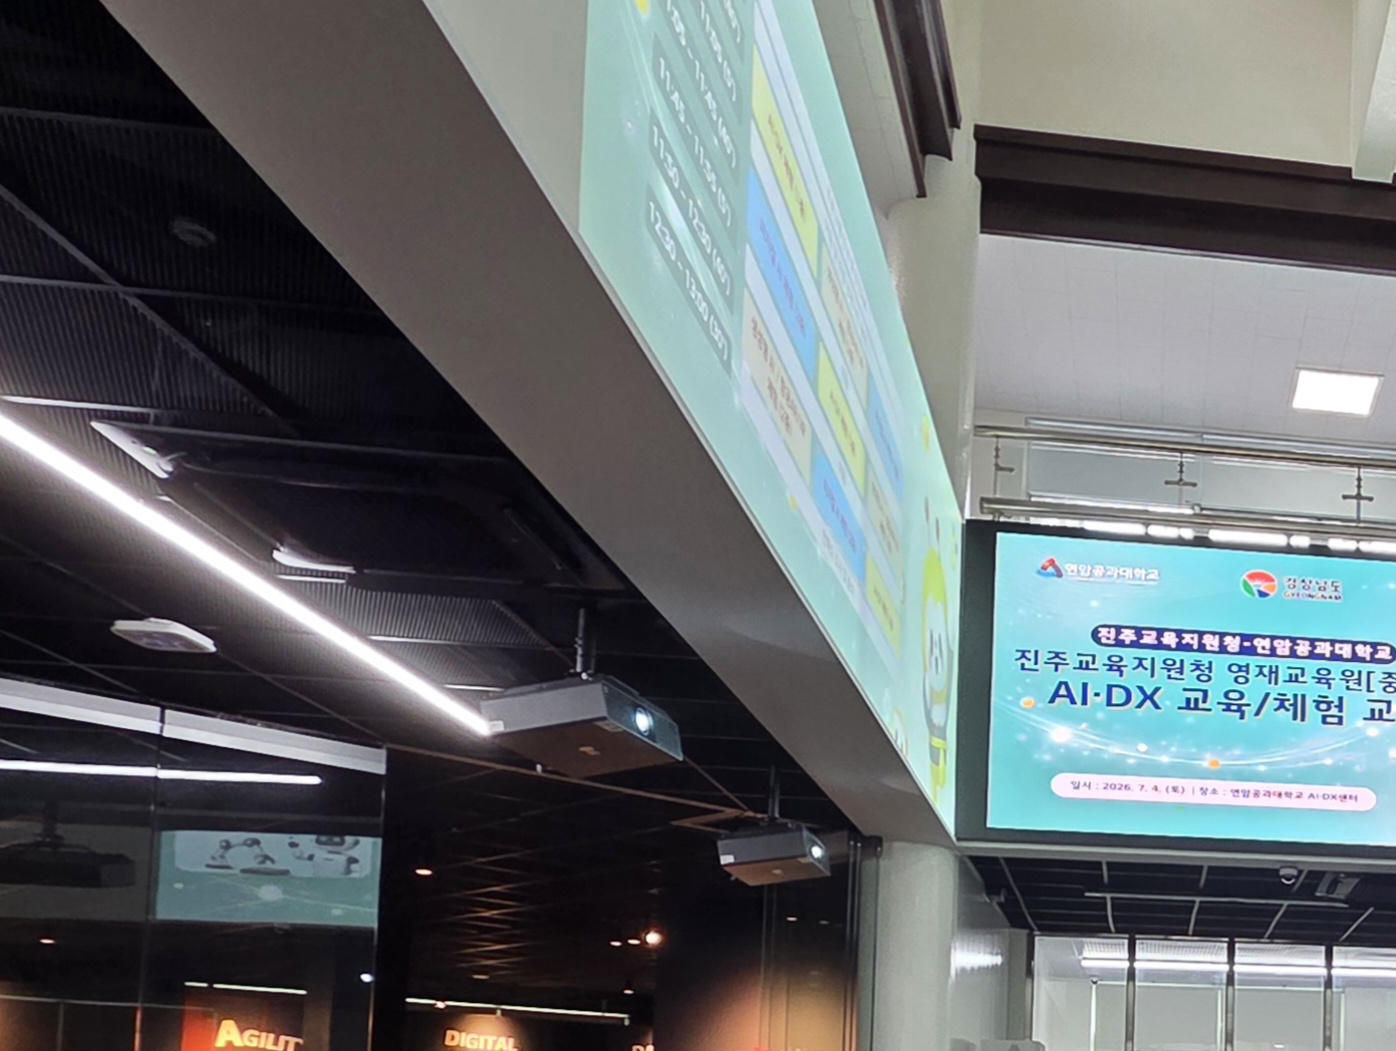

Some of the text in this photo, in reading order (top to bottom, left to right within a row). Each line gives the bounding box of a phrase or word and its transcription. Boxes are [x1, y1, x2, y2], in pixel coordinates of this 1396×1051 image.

[1065, 562, 1160, 581] 연암공과대학교
[1284, 577, 1341, 592] 경상남도
[1014, 648, 1214, 684] 진주교육지원청
[1047, 680, 1163, 711] AI·DX
[1177, 686, 1345, 726] 교육/체험
[1070, 780, 1091, 790] 일시
[1199, 787, 1219, 796] 장소
[1230, 788, 1303, 800] 연암공과대학교
[444, 1029, 518, 1051] DIGITAL
